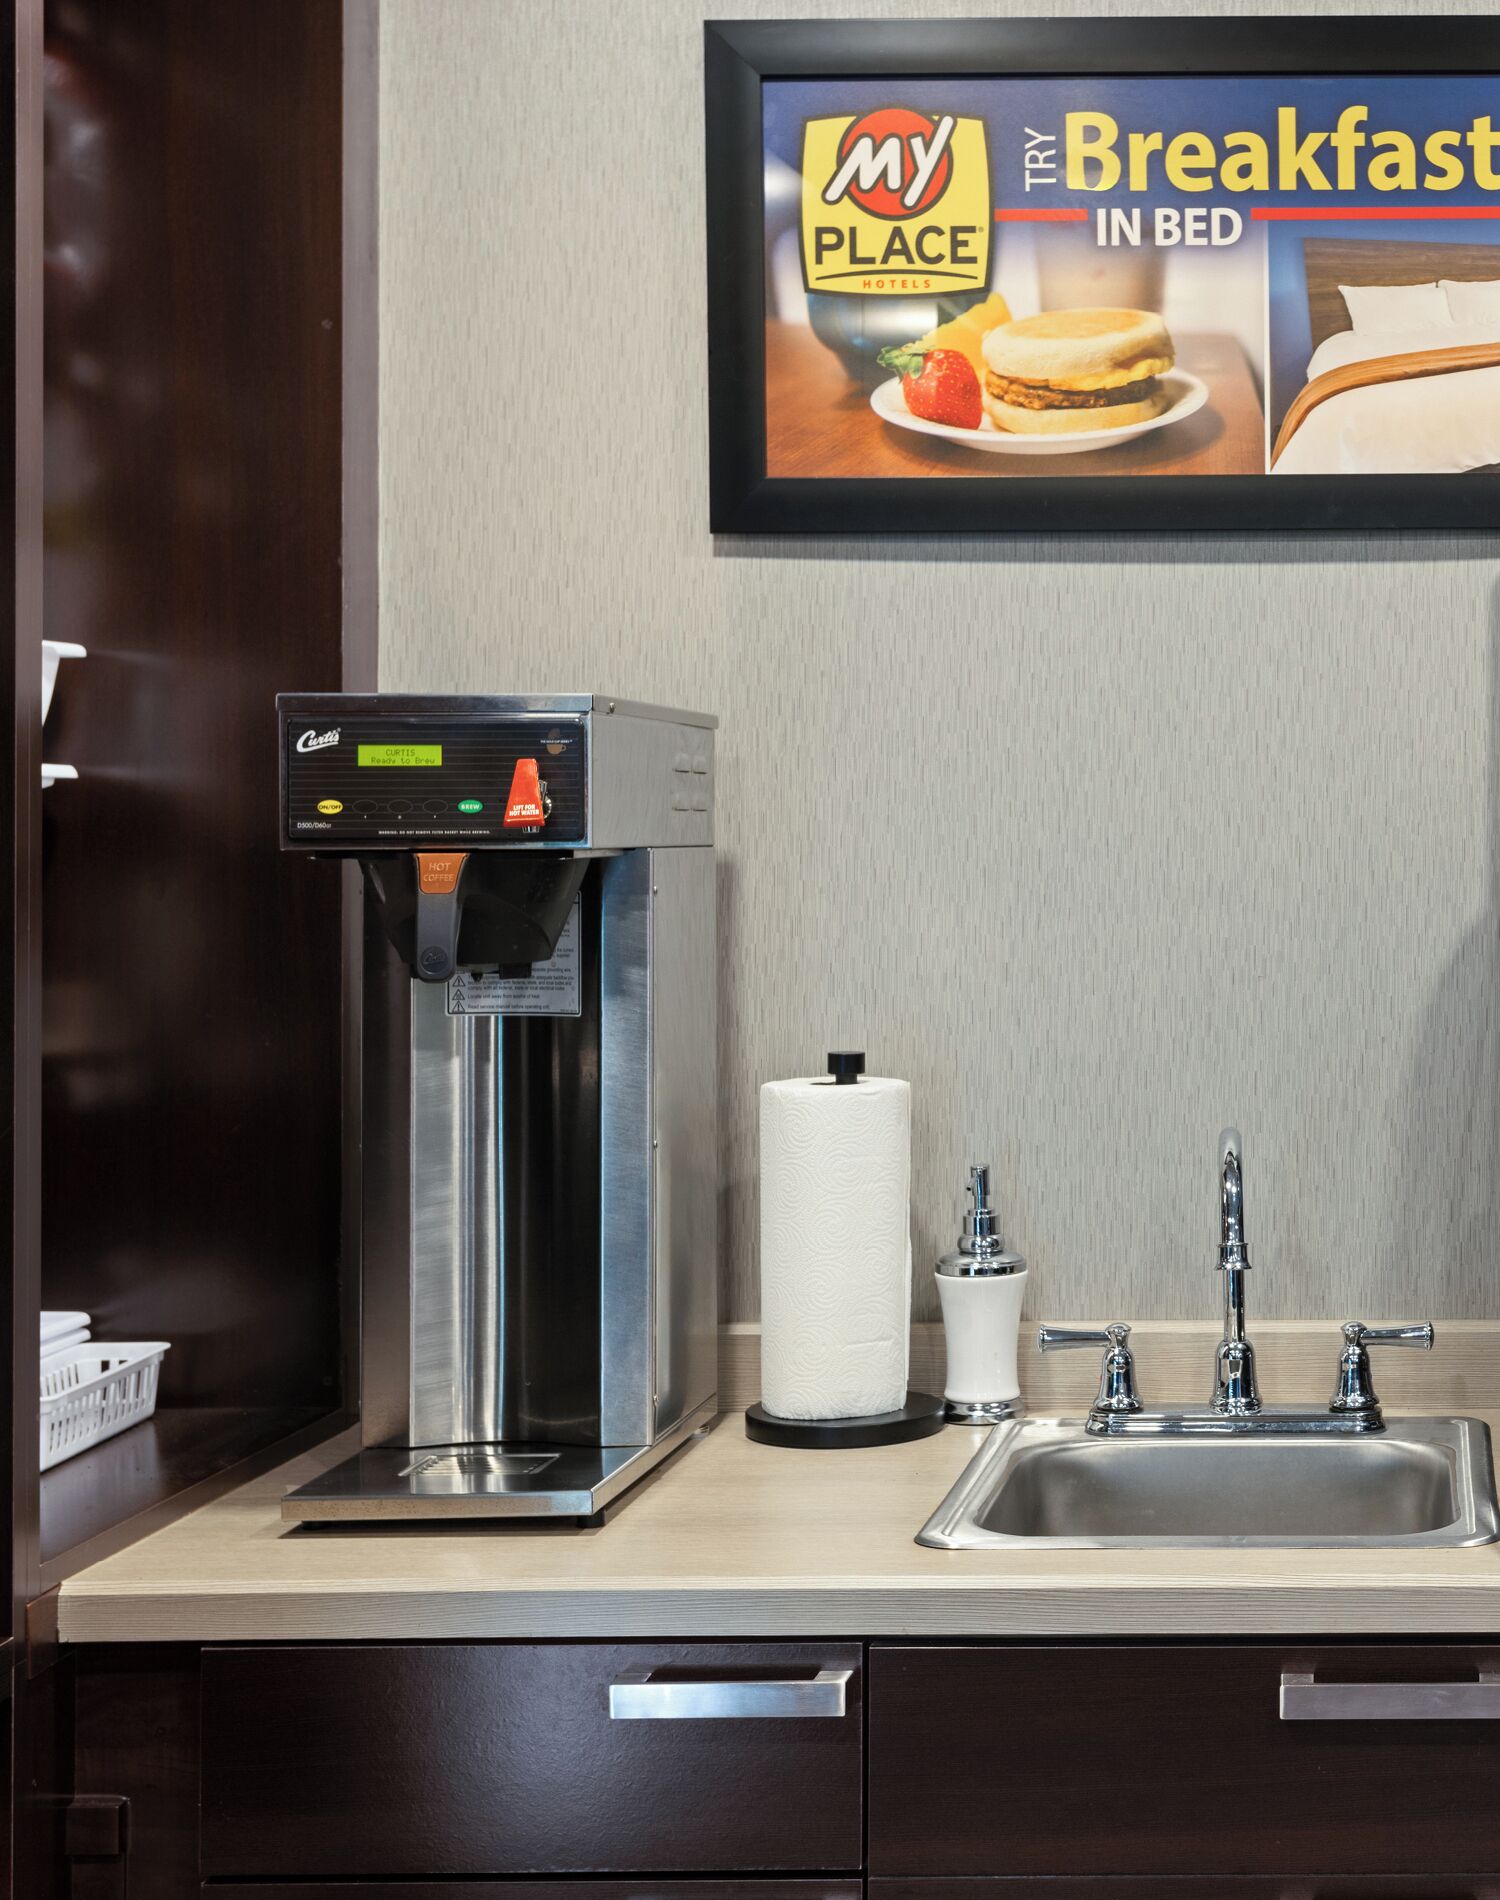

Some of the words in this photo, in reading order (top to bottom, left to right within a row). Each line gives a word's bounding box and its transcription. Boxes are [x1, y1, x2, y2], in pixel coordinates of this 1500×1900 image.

[1023, 126, 1057, 192] TRY
[1096, 208, 1139, 247] IN
[1154, 207, 1244, 247] BED
[813, 225, 979, 266] PLACE
[862, 278, 933, 290] HOTELS
[296, 730, 340, 753] Curtis
[385, 749, 416, 757] CURTIS
[371, 757, 396, 765] Ready
[401, 757, 411, 765] to
[415, 757, 435, 765] Brew
[428, 862, 451, 871] HOT
[424, 874, 454, 882] COFFEE
